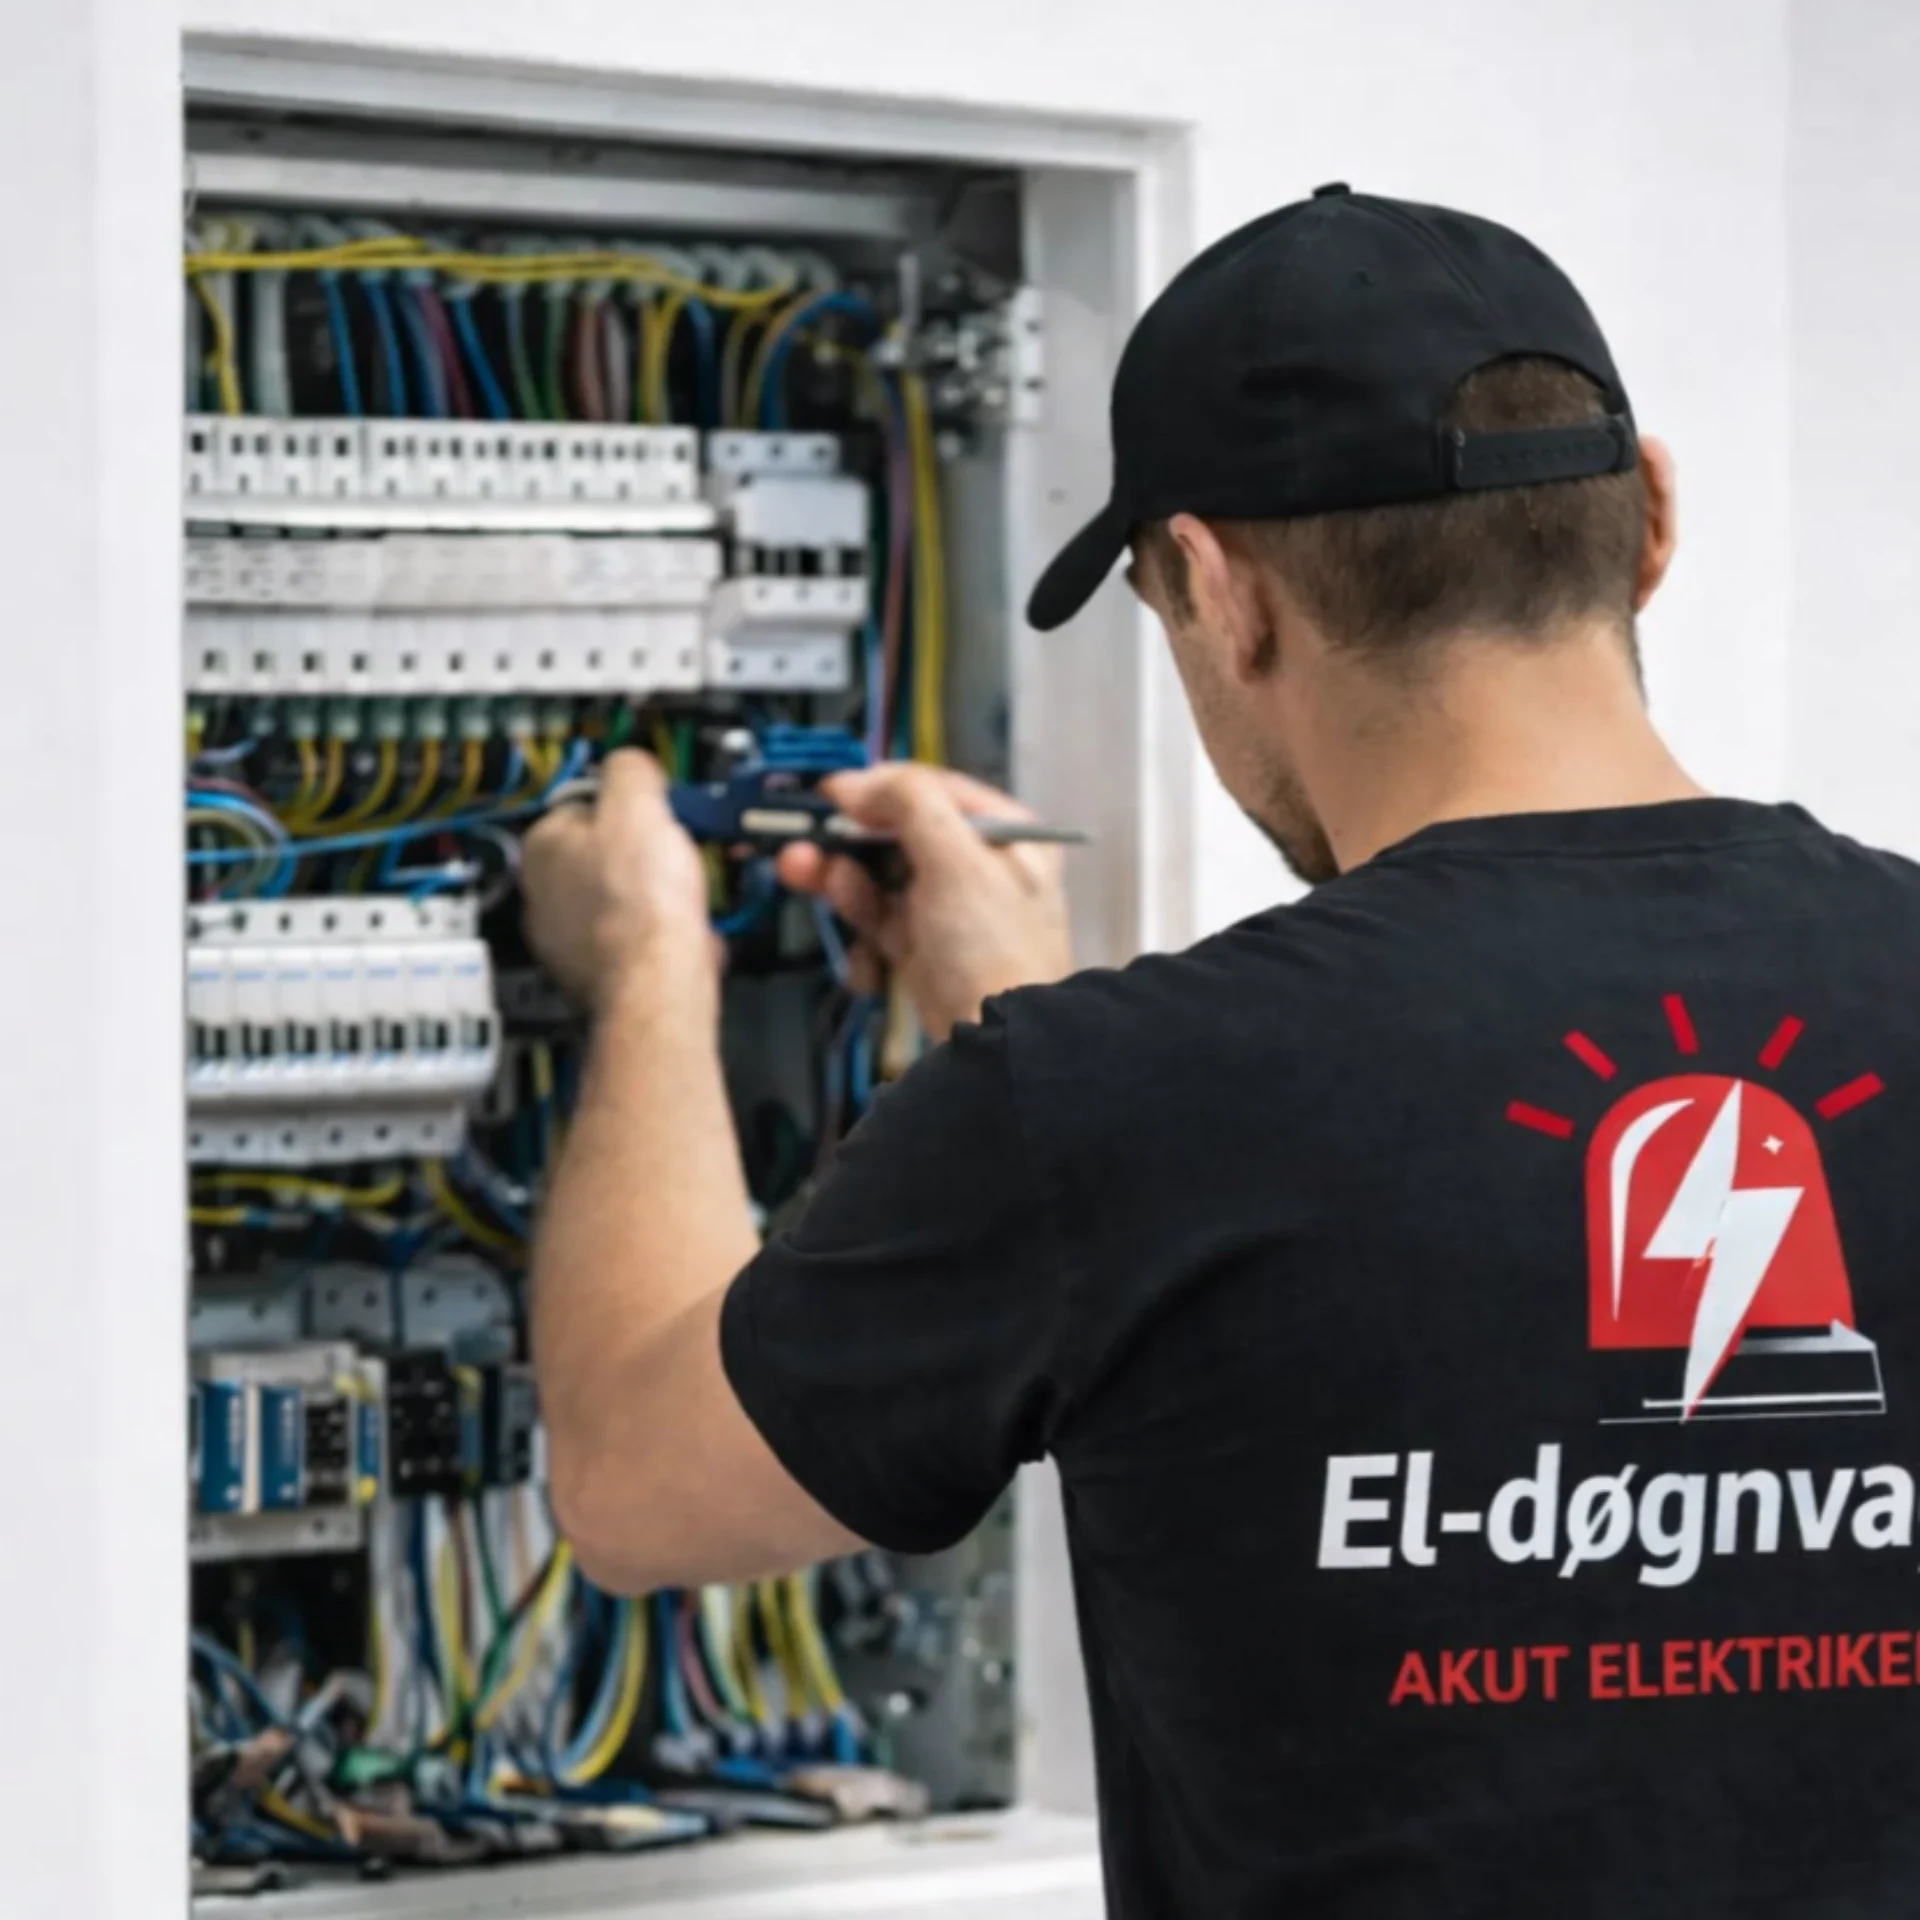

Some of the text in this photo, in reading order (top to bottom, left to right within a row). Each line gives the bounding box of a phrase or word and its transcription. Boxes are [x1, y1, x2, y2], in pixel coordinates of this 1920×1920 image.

[1317, 1443, 1920, 1588] El-døgnva
[1390, 1631, 1920, 1705] AKUT ELEKTRIKE
